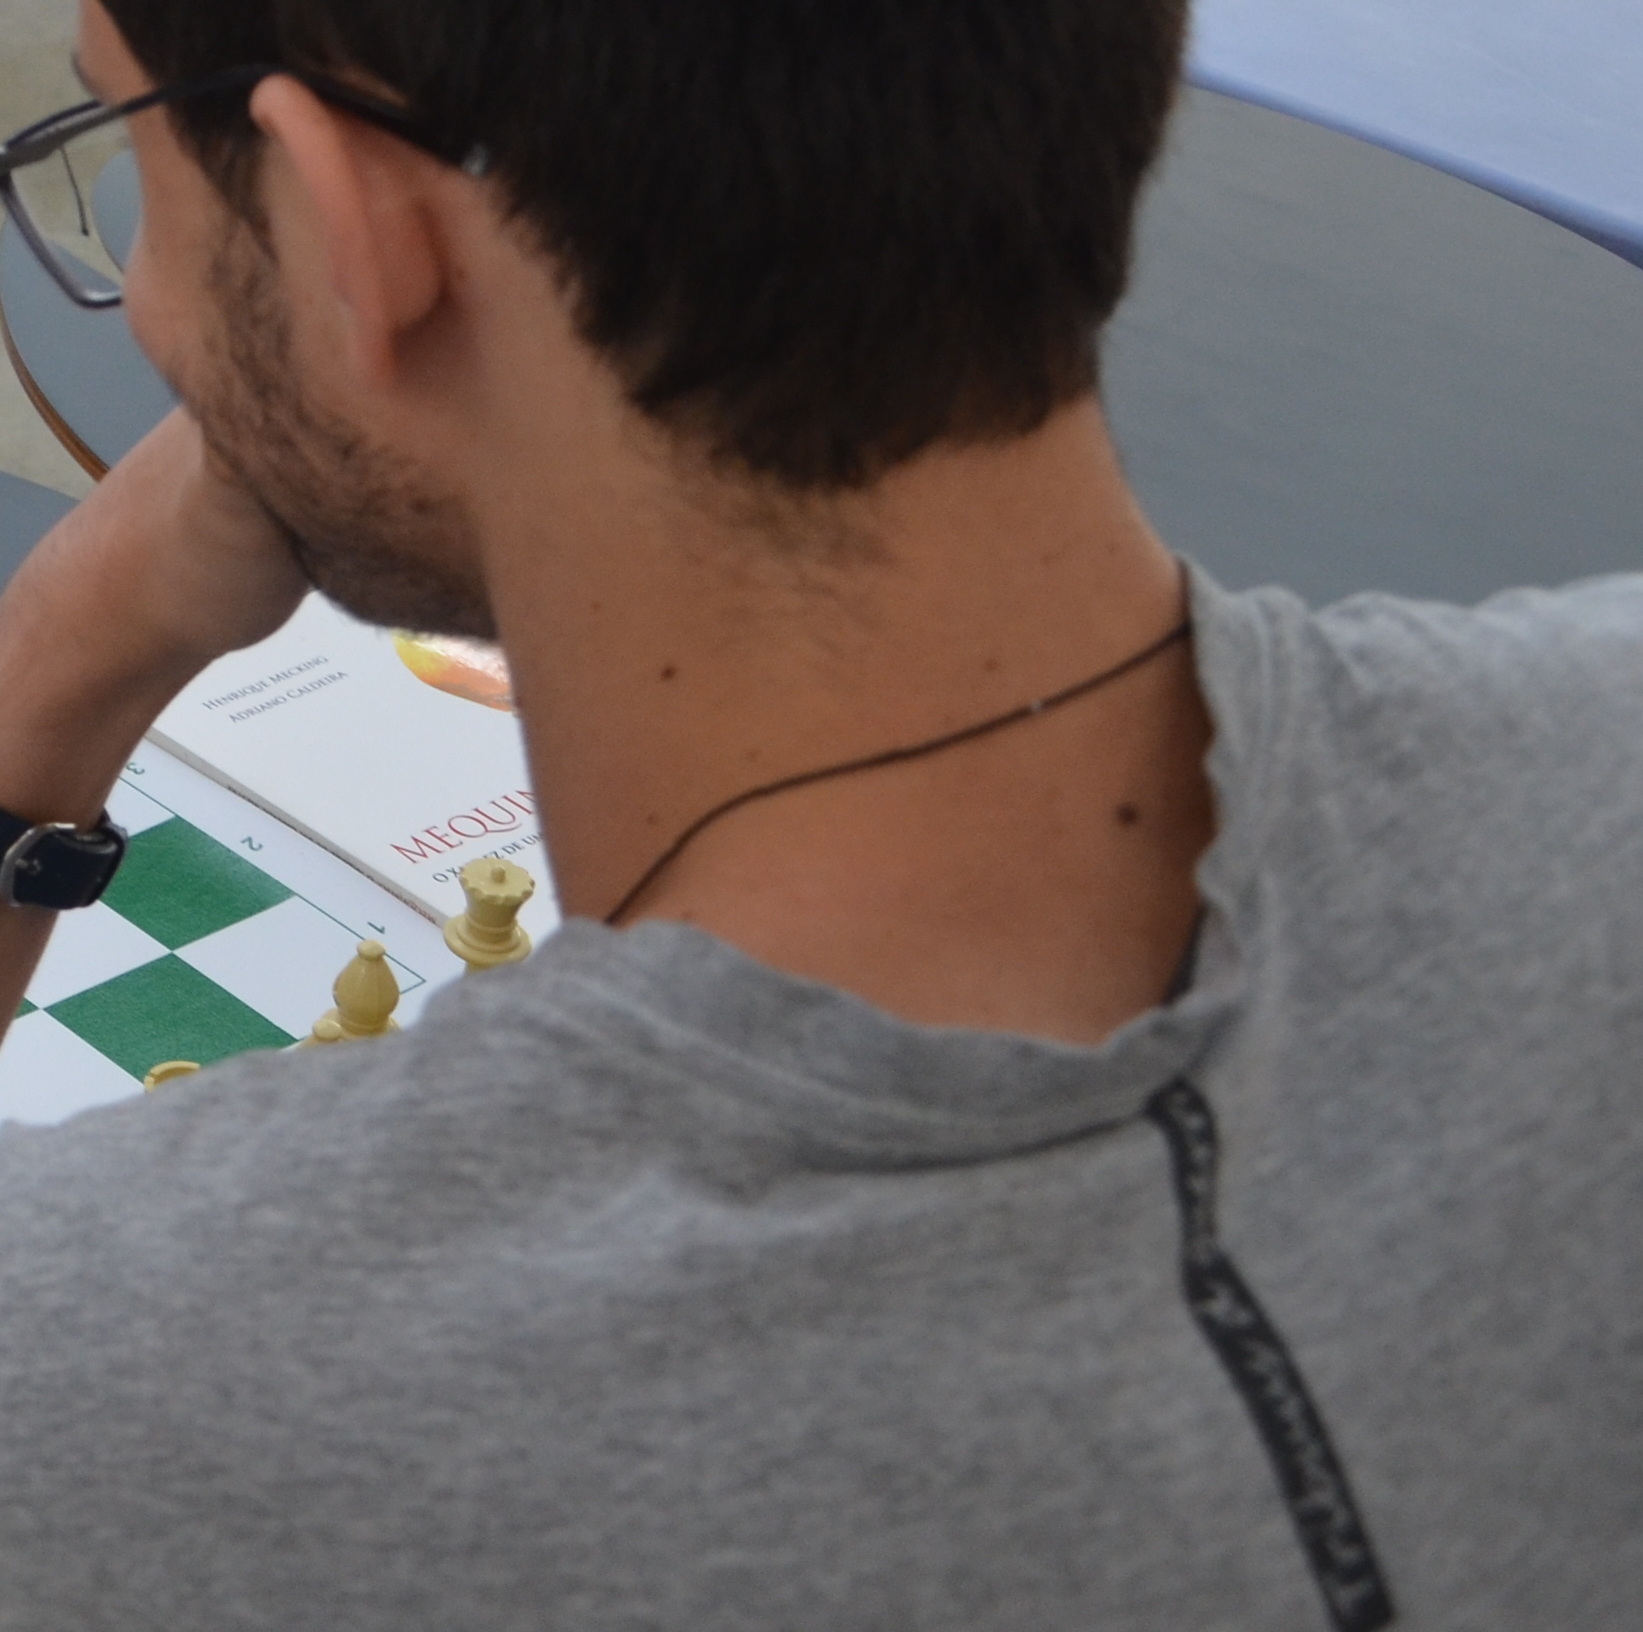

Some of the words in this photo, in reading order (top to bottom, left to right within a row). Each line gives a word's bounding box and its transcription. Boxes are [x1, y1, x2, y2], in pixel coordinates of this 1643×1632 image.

[202, 680, 270, 710] HENRIQUE
[269, 655, 329, 685] MECKING
[228, 695, 288, 724] ADRIANO
[286, 671, 348, 699] CALDEIRA
[126, 762, 146, 776] 3
[241, 835, 264, 853] 2
[501, 841, 525, 855] DE
[367, 920, 386, 935] 1
